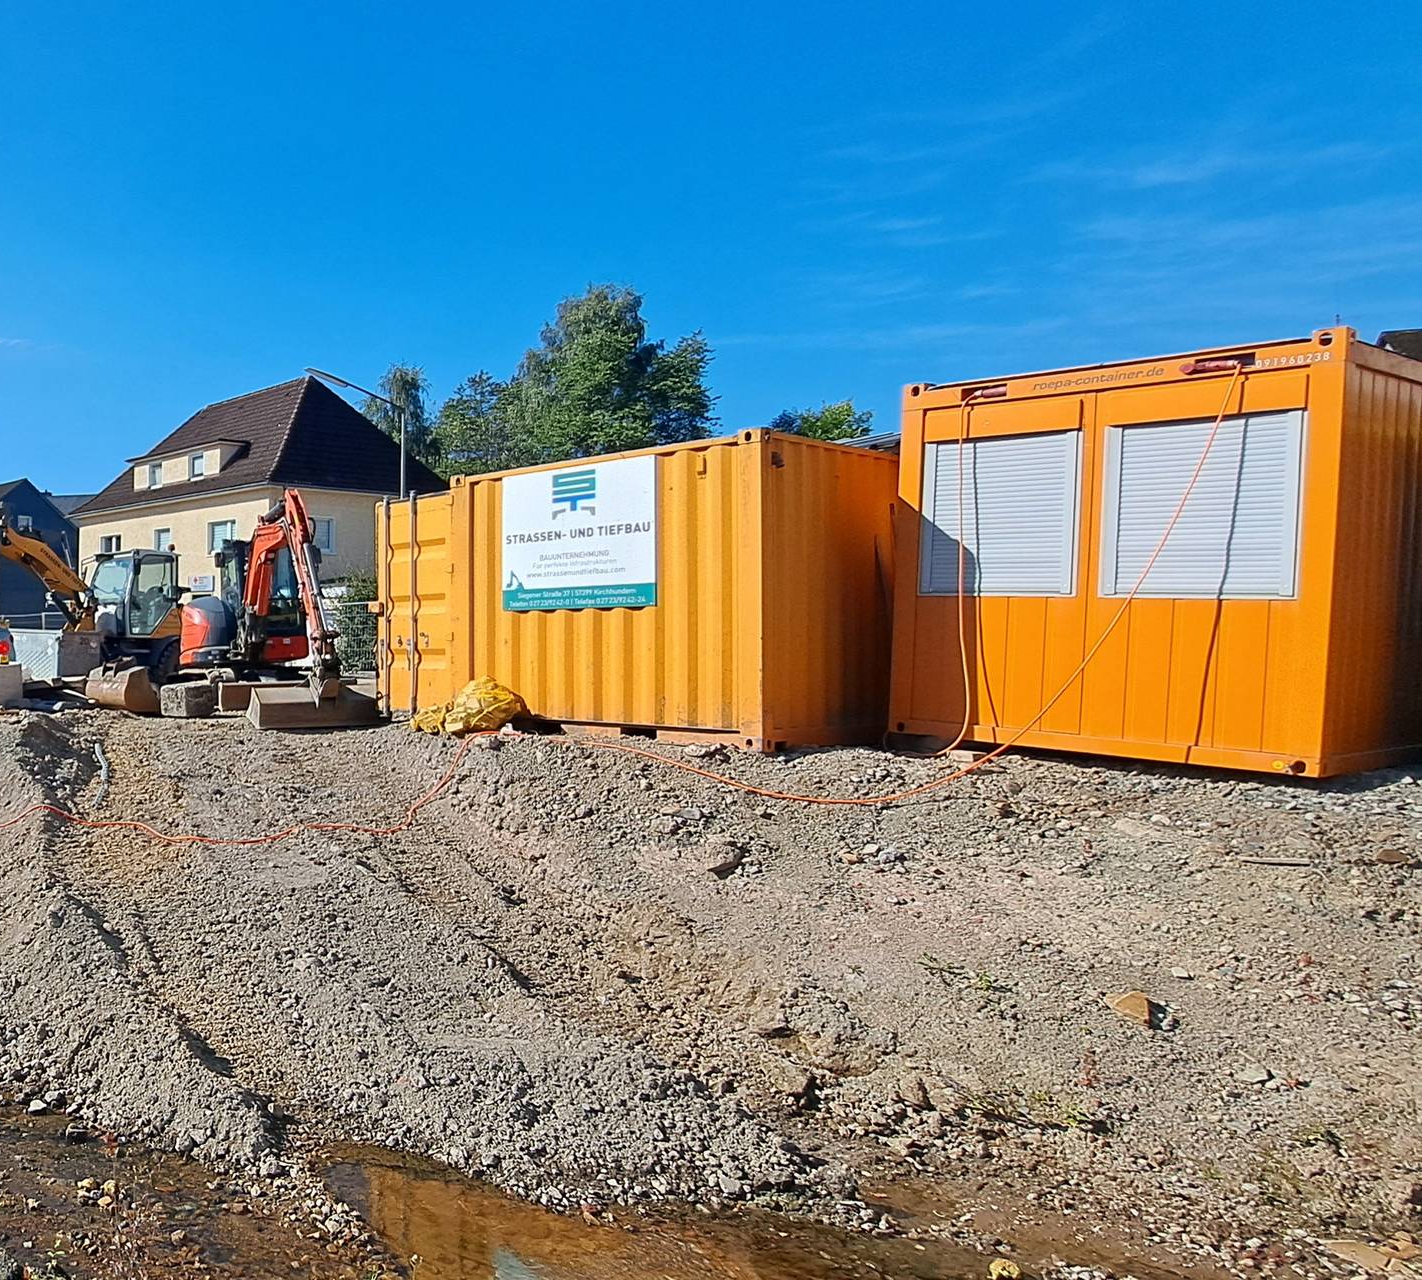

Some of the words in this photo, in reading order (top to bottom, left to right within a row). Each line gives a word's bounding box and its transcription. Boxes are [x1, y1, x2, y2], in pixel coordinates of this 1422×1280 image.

[1033, 366, 1165, 391] roepa-container.de
[505, 530, 567, 545] STRASSEN-
[570, 527, 594, 539] UND
[597, 521, 651, 537] TIEFBAU
[539, 549, 610, 561] BAUUNTERNEHMUNG
[526, 566, 626, 579] www.strassenundtiefbau.com
